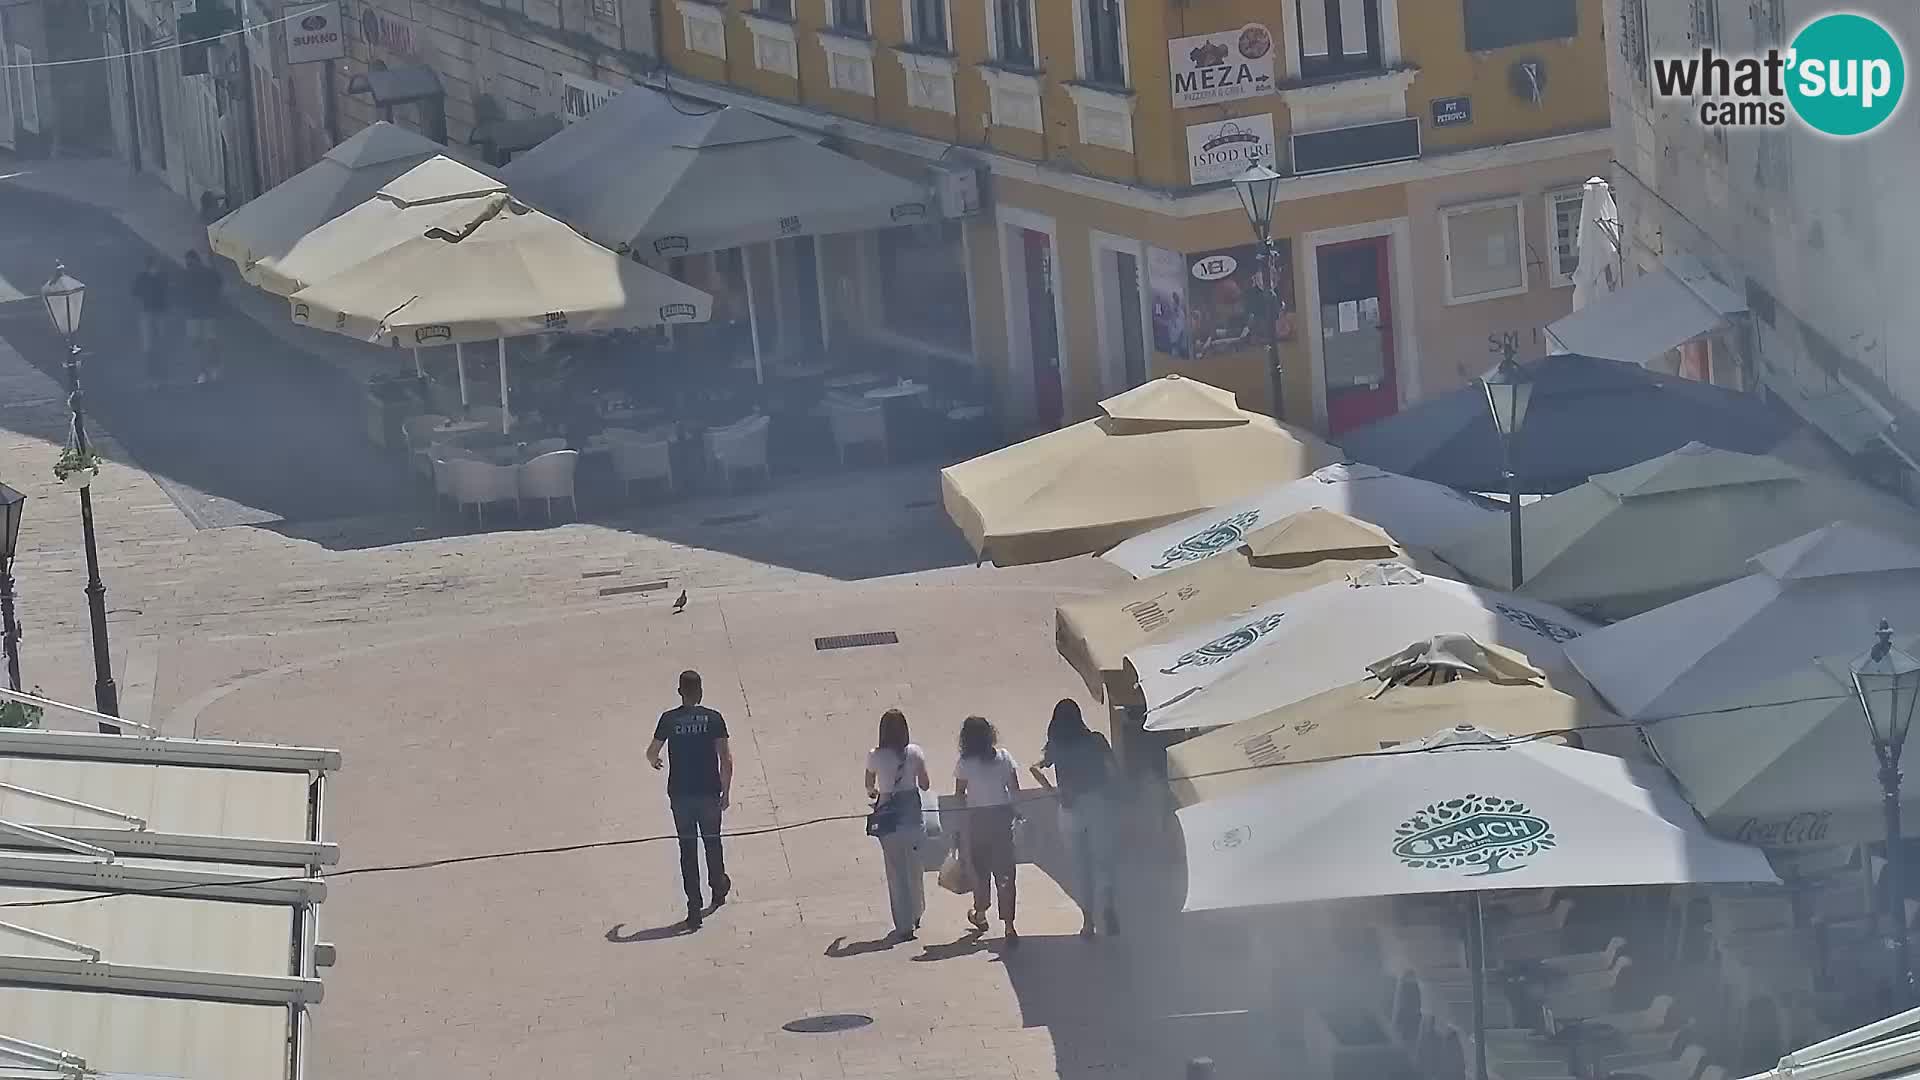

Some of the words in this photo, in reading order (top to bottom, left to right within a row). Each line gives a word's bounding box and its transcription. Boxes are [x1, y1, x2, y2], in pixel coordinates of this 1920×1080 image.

[292, 32, 338, 47] SUKNO
[1175, 63, 1254, 94] MEZA
[1193, 149, 1239, 167] ISPOD
[1432, 820, 1532, 850] RAUCH
